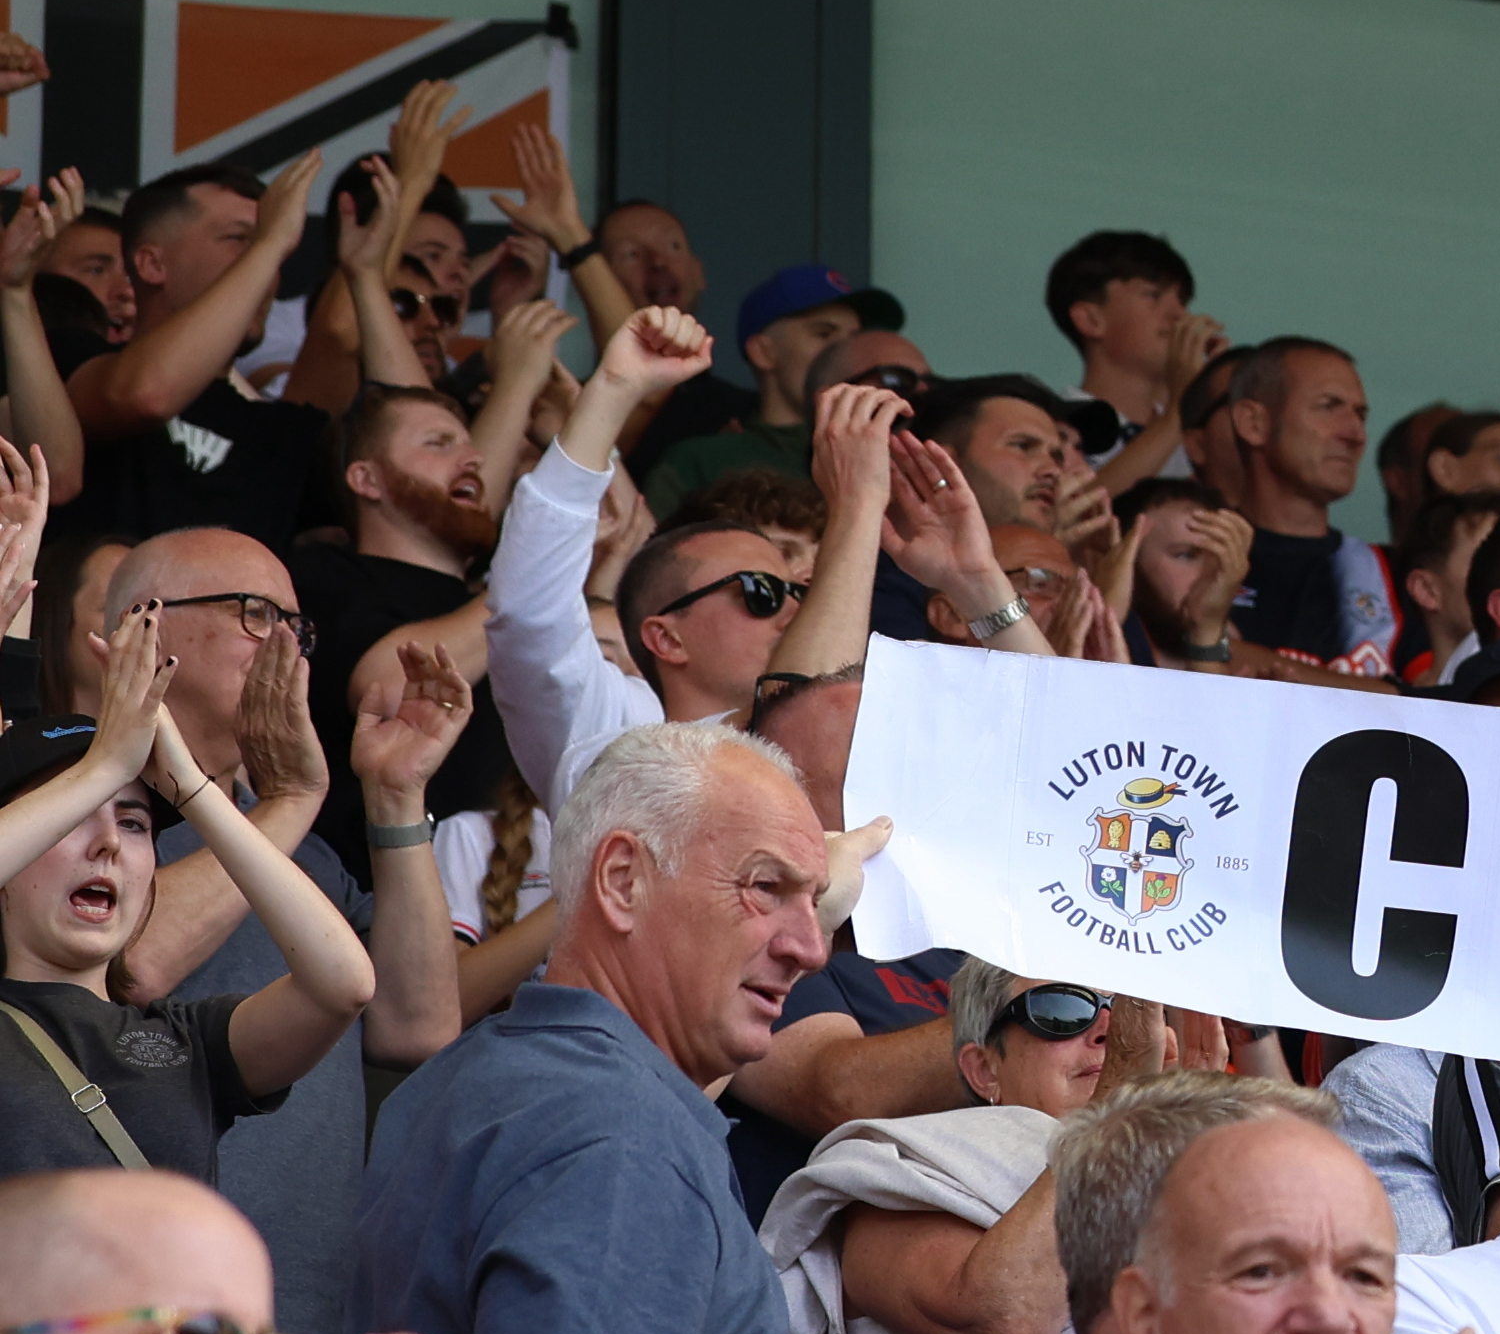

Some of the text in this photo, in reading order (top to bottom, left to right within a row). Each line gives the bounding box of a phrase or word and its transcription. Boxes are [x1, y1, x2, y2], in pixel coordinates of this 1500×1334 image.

[1047, 740, 1240, 820] LUTON TOWN
[1025, 830, 1249, 871] EST 1885
[1038, 880, 1228, 954] FOOTBALL CLUB
